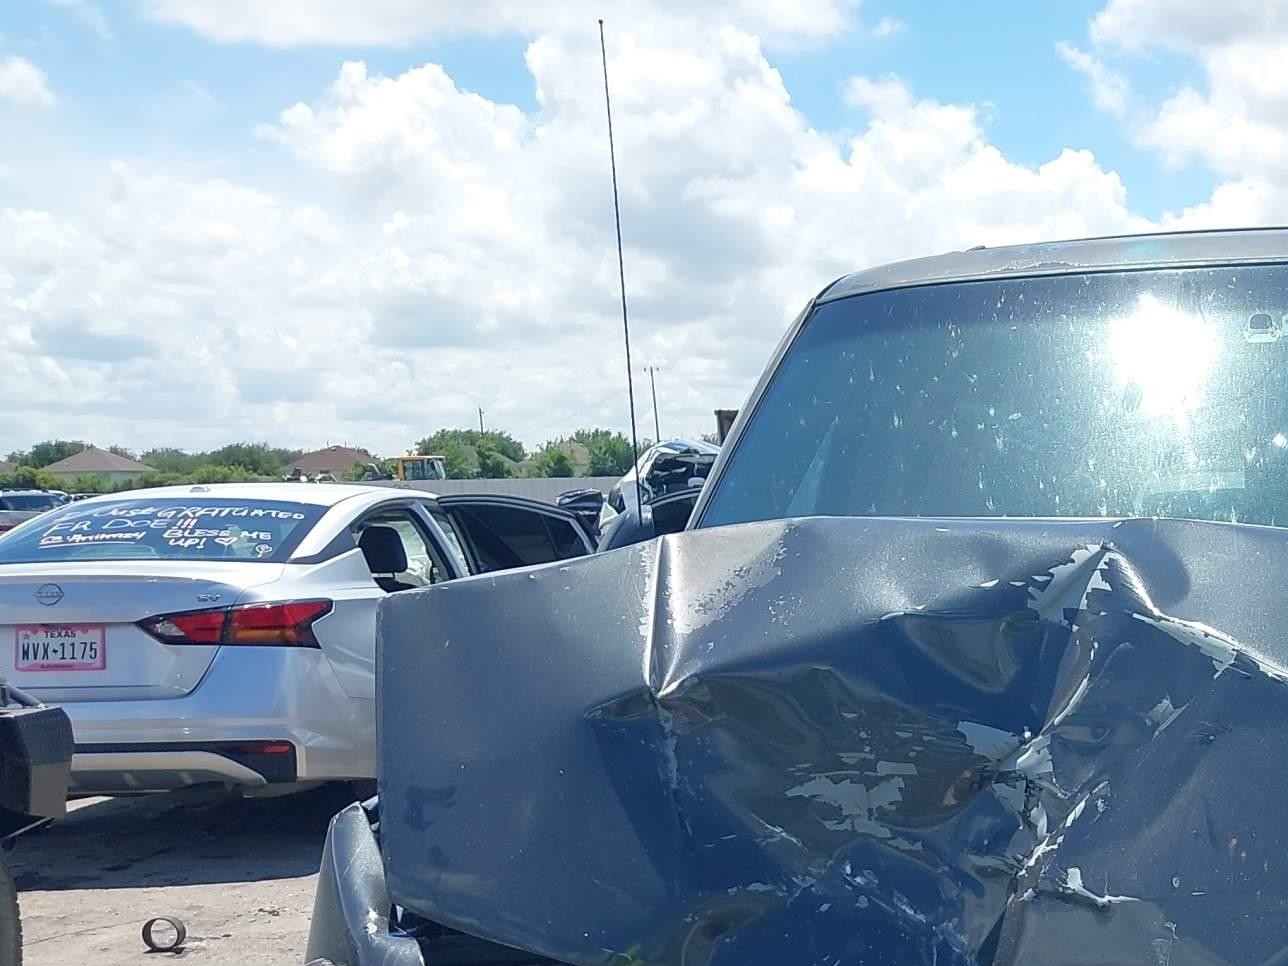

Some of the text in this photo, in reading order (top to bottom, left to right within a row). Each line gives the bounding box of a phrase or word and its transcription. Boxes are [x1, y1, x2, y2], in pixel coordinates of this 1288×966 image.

[163, 528, 272, 540] BLESS ME
[197, 593, 221, 602] SV
[44, 630, 77, 639] TEXAS
